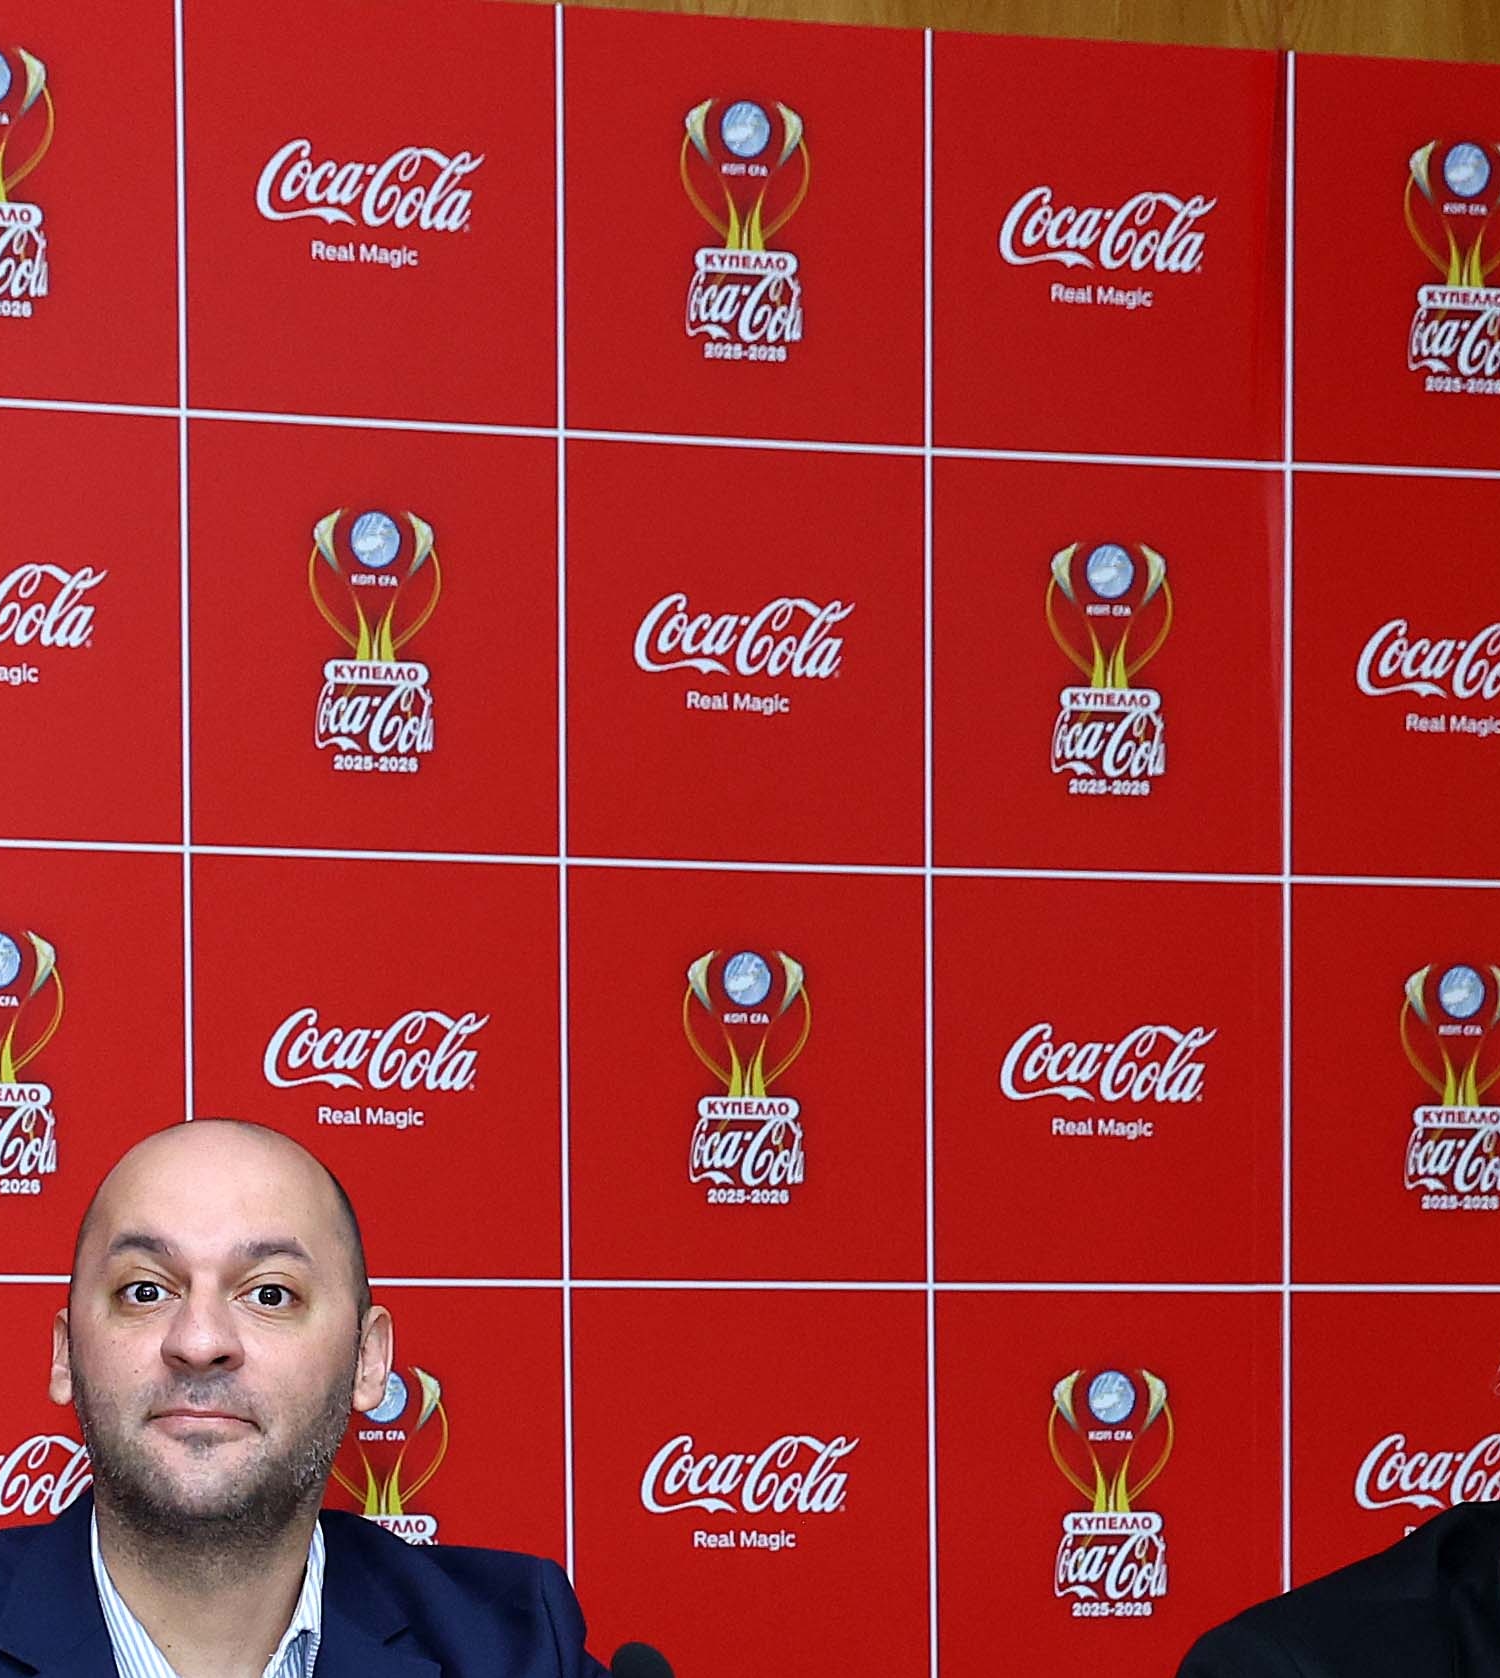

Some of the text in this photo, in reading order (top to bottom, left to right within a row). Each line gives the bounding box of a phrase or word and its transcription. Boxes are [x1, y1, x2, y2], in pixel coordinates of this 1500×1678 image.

[255, 139, 484, 231] Coca-Cola
[998, 185, 1217, 272] Coca-Cola
[311, 240, 418, 268] Real Magic
[704, 252, 787, 271] ΚΥΠΕΛΛΟ
[1050, 283, 1152, 309] Real Magic
[703, 342, 786, 361] 2025-2026
[633, 592, 855, 678] Coca-Cola
[333, 664, 418, 681] ΚΥΠΕΛΛΟ
[686, 690, 790, 715] Real Magic
[1069, 691, 1150, 707] ΚΥΠΕΛΛΟ
[1405, 713, 1445, 732] Real
[333, 754, 418, 772] 2025-2026
[263, 1007, 489, 1091] Coca-Cola
[999, 1022, 1217, 1102] Coca-Cola
[318, 1106, 424, 1129] Real Magic
[707, 1100, 789, 1116] ΚΥΠΕΛΛΟ
[1051, 1117, 1153, 1140] Real Magic
[706, 1188, 789, 1204] 2025-2026
[640, 1434, 859, 1513] Coca-Cola
[1072, 1515, 1152, 1530] ΚΥΠΕΛΛΟ
[693, 1529, 796, 1551] Real Magic
